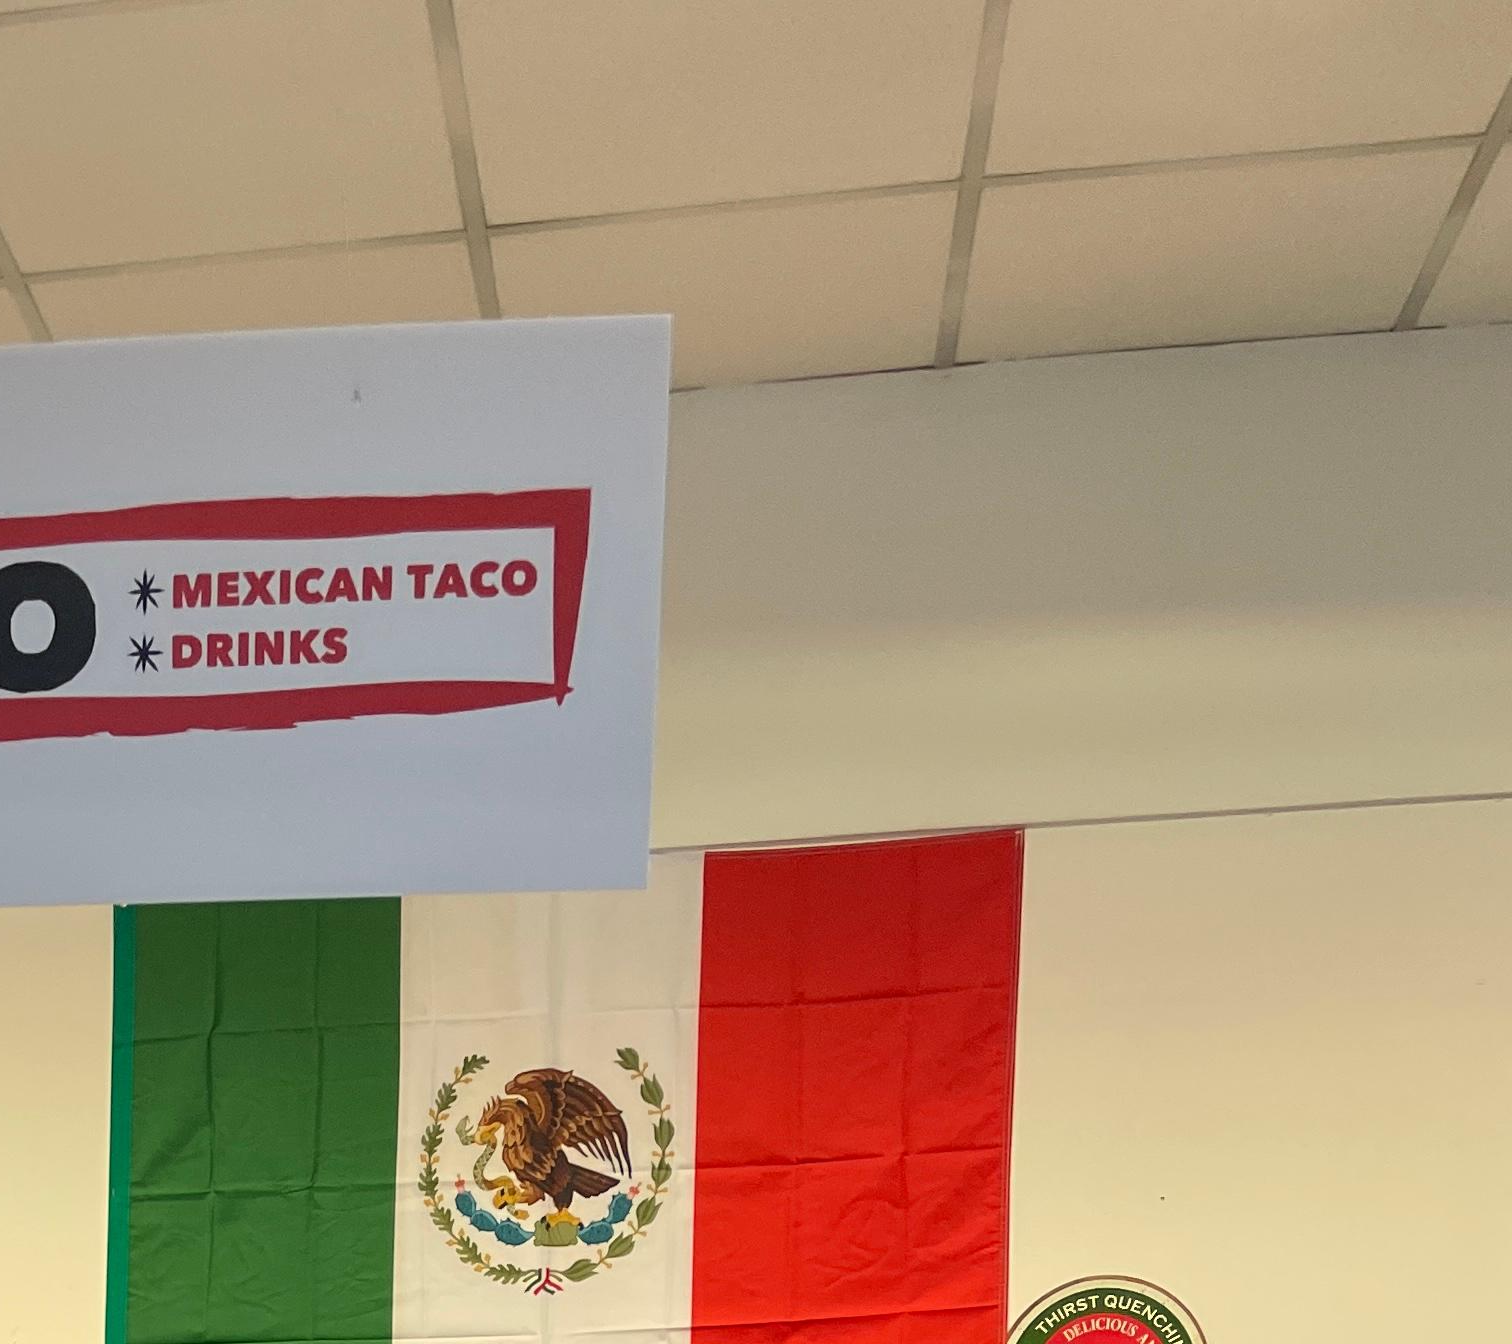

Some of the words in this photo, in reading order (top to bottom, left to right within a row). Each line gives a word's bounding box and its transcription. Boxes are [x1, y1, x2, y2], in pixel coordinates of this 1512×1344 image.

[171, 563, 394, 610] MEXICAN
[406, 558, 539, 600] TACO
[171, 629, 349, 671] DRINKS
[1035, 1295, 1099, 1335] THIRST
[1062, 1317, 1138, 1341] DELICIOUS
